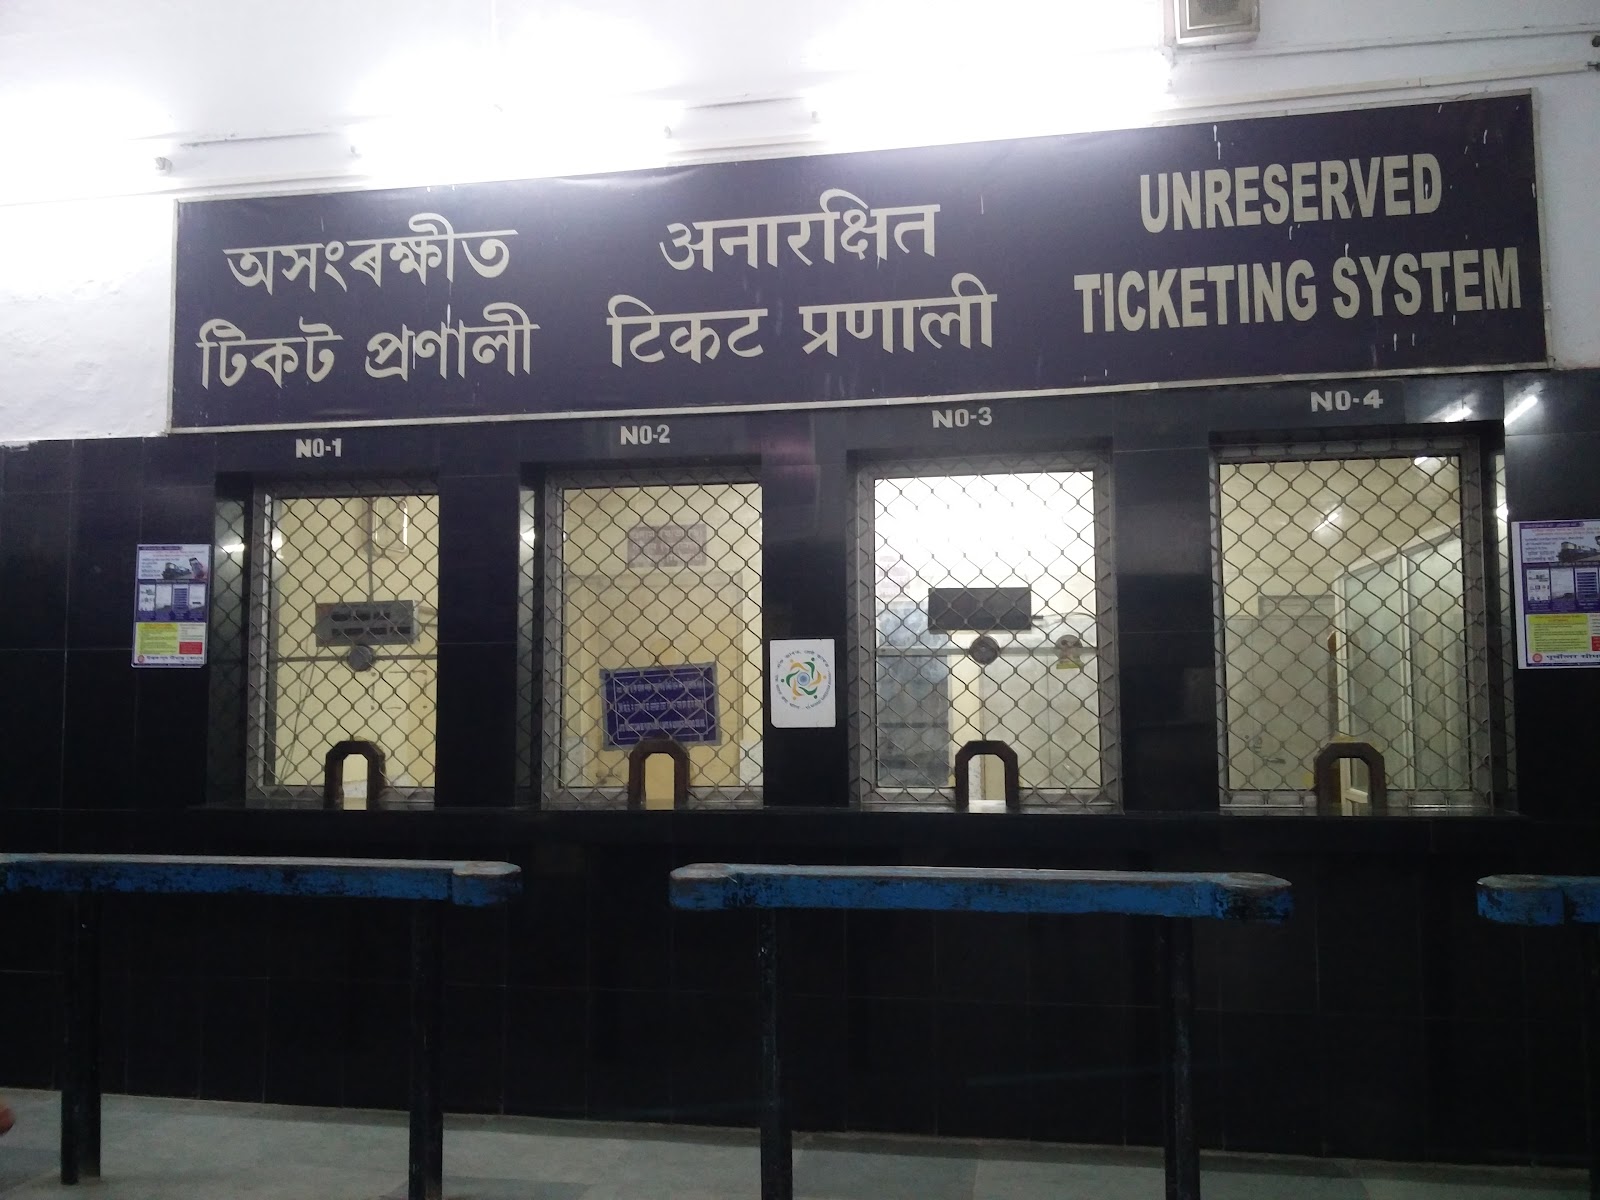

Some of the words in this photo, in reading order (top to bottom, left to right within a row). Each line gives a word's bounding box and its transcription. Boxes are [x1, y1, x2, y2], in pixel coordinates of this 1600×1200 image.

[659, 188, 941, 273] अनारक्षित
[1139, 153, 1442, 234] UNRESERVED
[222, 212, 519, 296] অসংৰক্ষীত
[1073, 259, 1317, 334] TICKETING
[1332, 246, 1522, 320] SYSTEM
[195, 316, 344, 390] টিকট
[364, 302, 541, 382] প্রণালী
[606, 294, 769, 369] टिकट
[798, 272, 998, 358] प्रणाली
[620, 423, 671, 446] NO-2
[931, 406, 993, 429] NO-3
[1310, 389, 1384, 413] NO-4
[295, 437, 342, 458] NO-1
